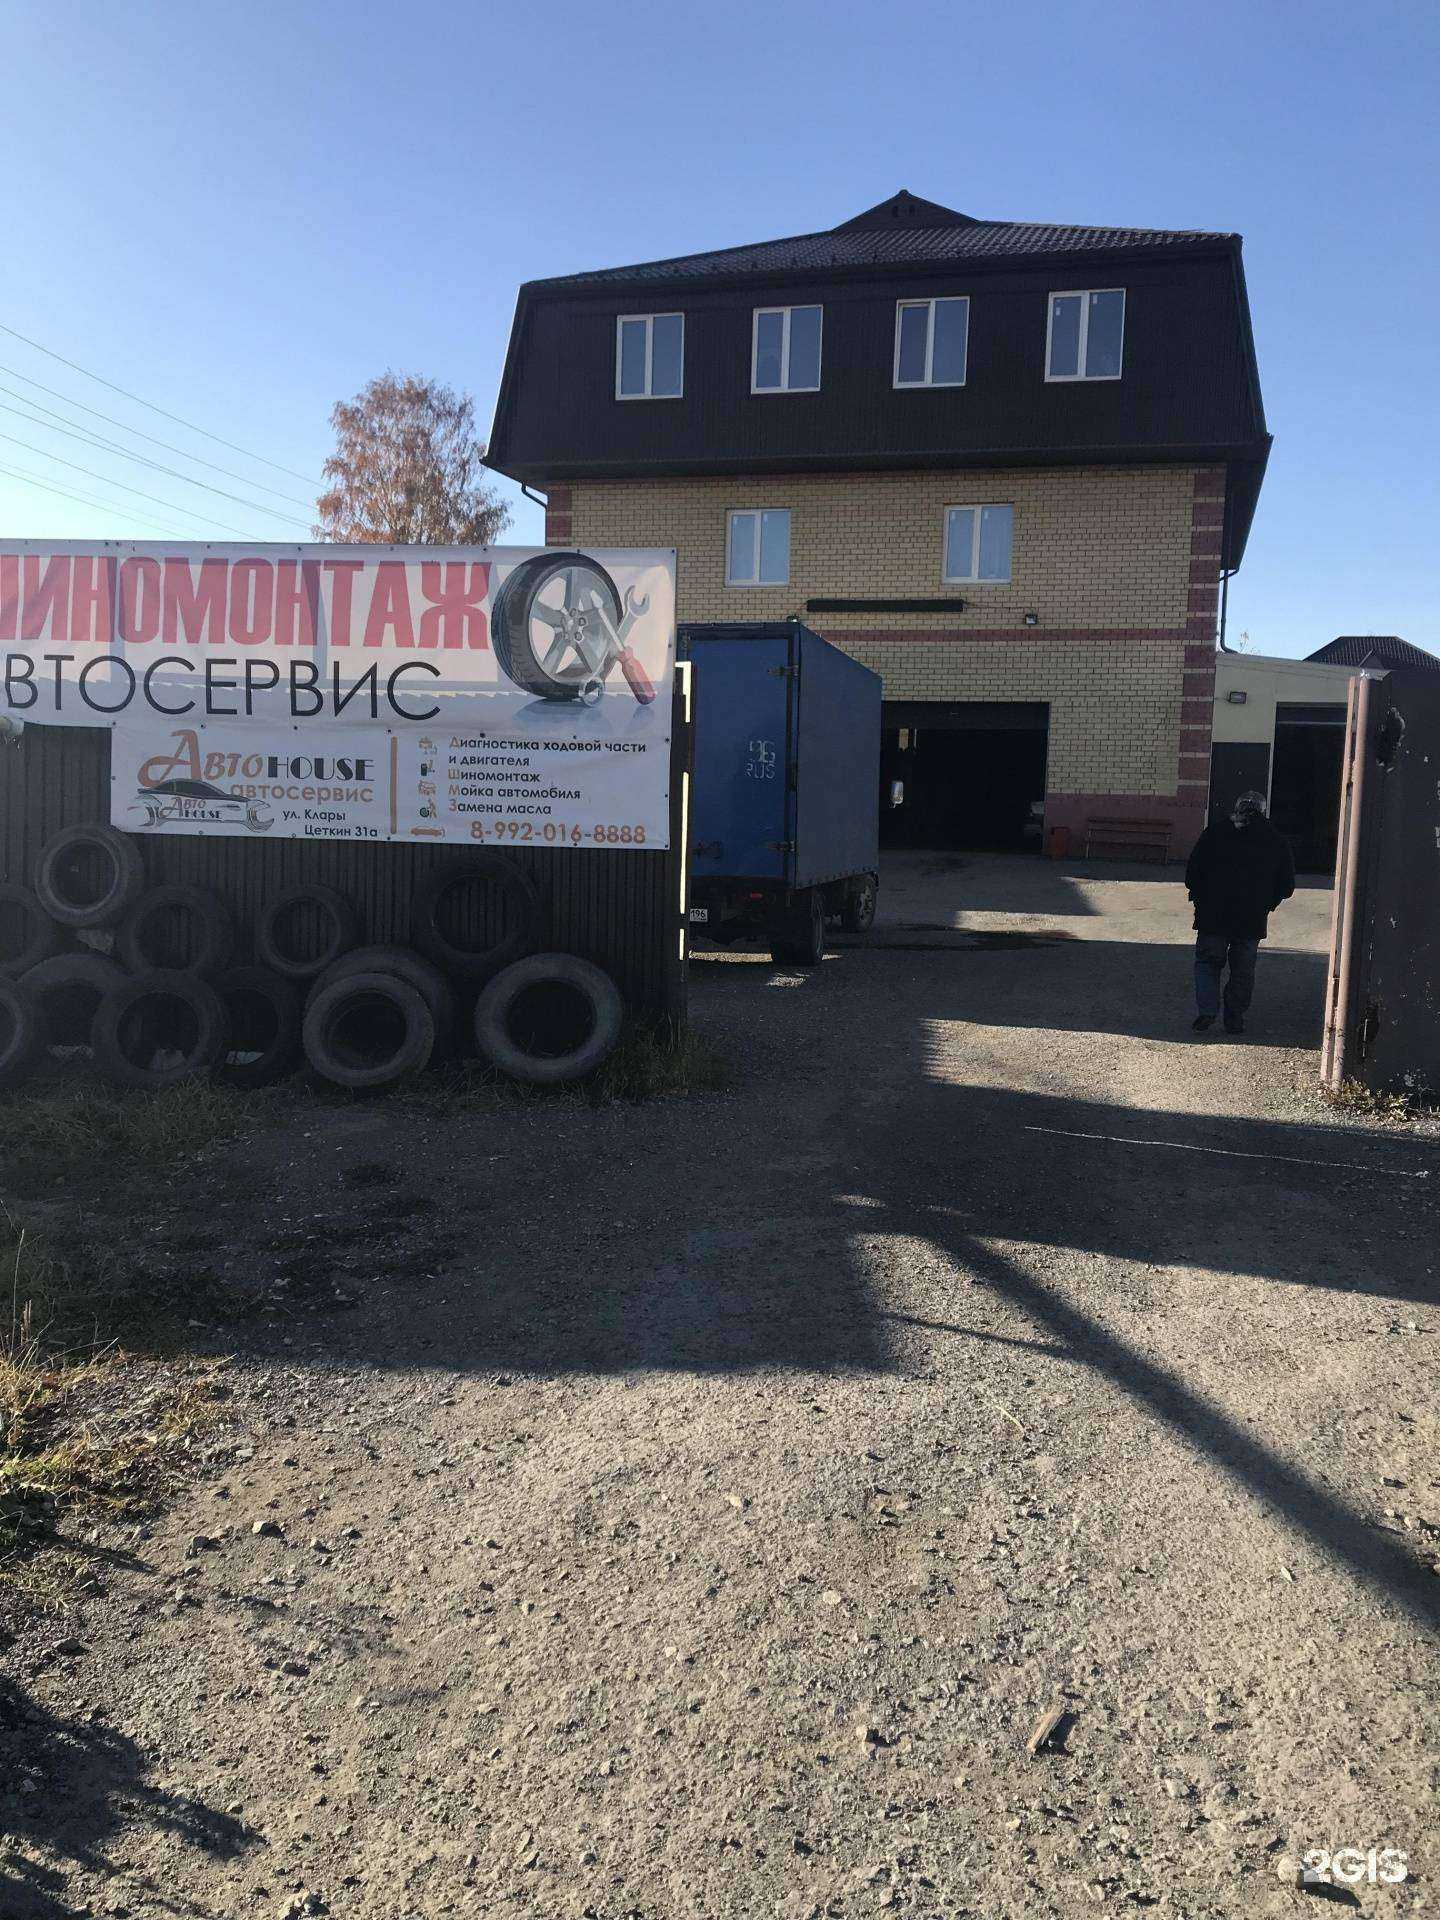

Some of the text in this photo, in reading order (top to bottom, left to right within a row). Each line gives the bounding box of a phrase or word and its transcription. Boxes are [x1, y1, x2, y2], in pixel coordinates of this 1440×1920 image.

[5, 653, 441, 721] ВТОСЕРВИС
[450, 736, 647, 753] Диагностика ходовой части
[449, 755, 530, 767] и двигателя
[448, 769, 541, 783] Шиномонтаж
[230, 783, 374, 805] автосервис
[448, 784, 581, 800] Мойка автомобиля
[283, 808, 346, 822] ул. Клары
[448, 799, 552, 815] Замена масла
[304, 824, 378, 838] Цеткин 31а
[470, 820, 647, 844] 8-992-016-8888
